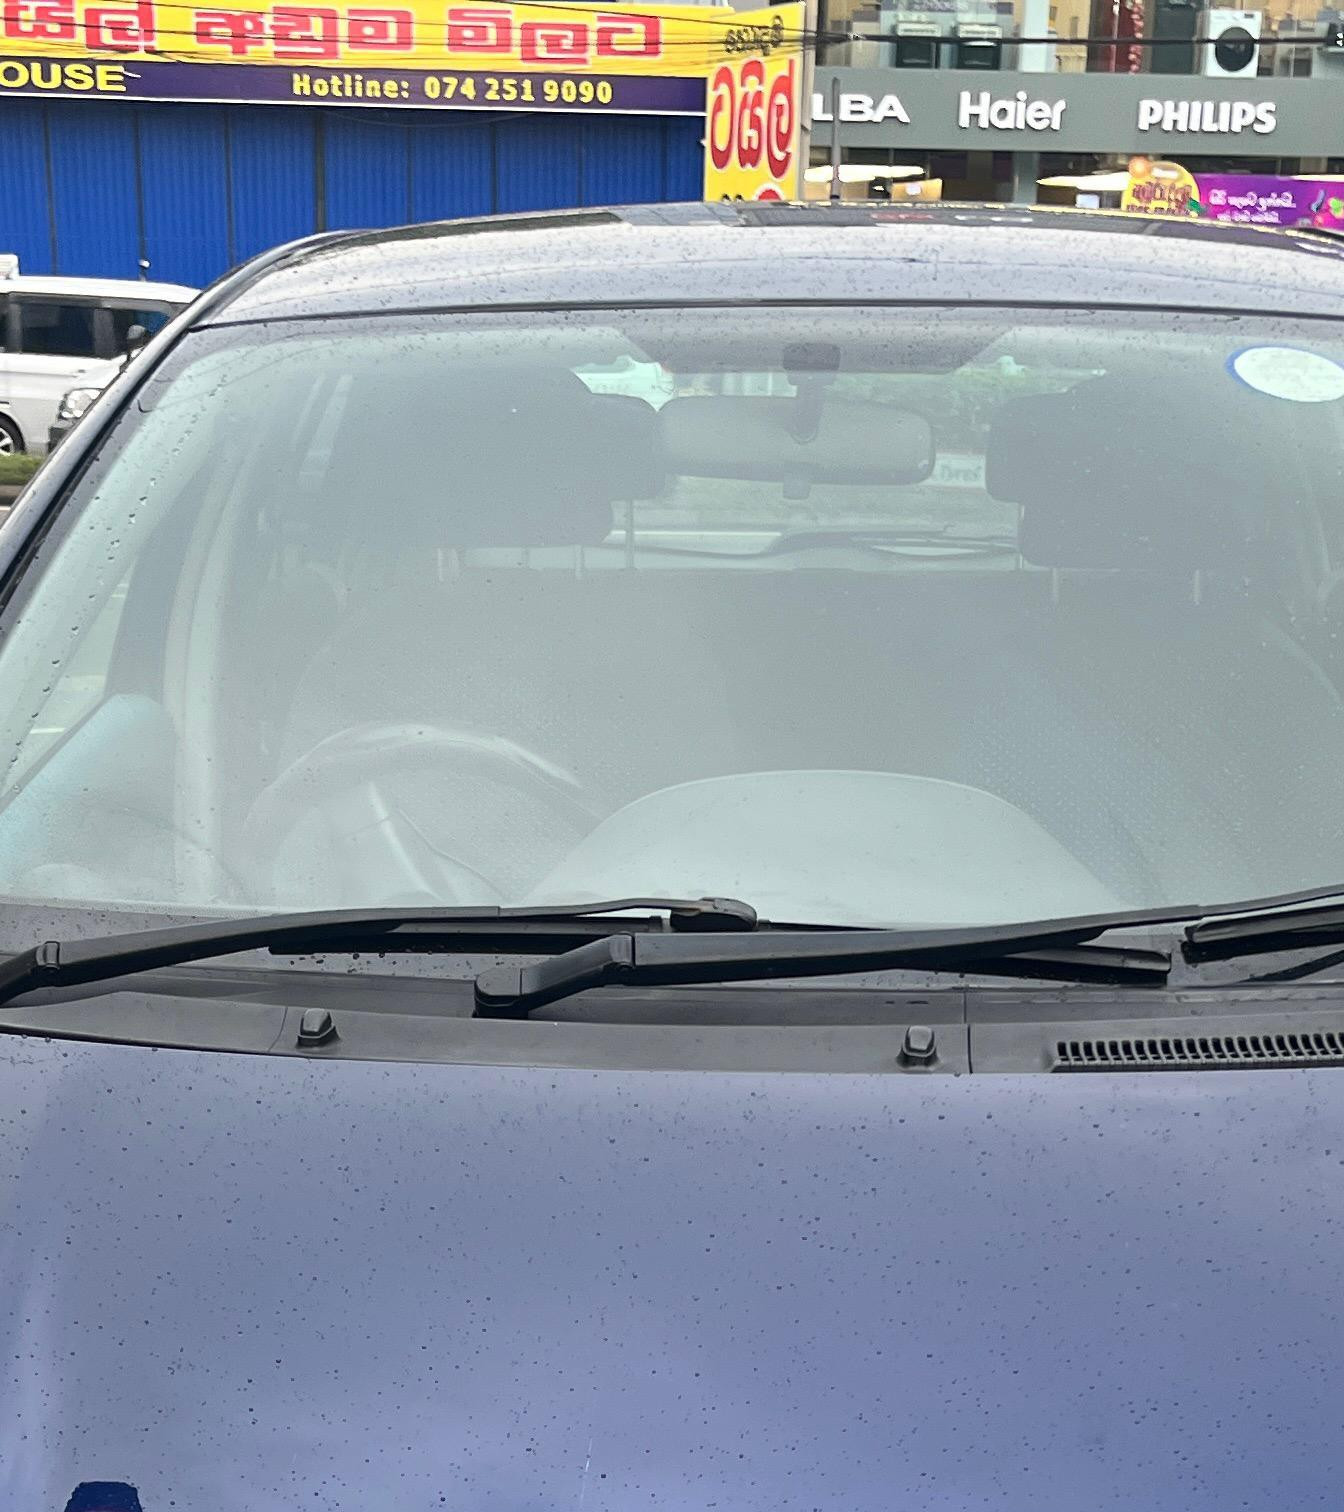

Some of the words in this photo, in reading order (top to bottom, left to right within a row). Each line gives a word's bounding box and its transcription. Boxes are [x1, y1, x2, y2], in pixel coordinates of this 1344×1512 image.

[292, 73, 410, 98] Hotline:
[423, 75, 477, 100] 074
[484, 77, 536, 102] 251
[543, 80, 614, 104] 9090
[958, 90, 1067, 131] Haier
[1137, 98, 1277, 134] PHILIPS
